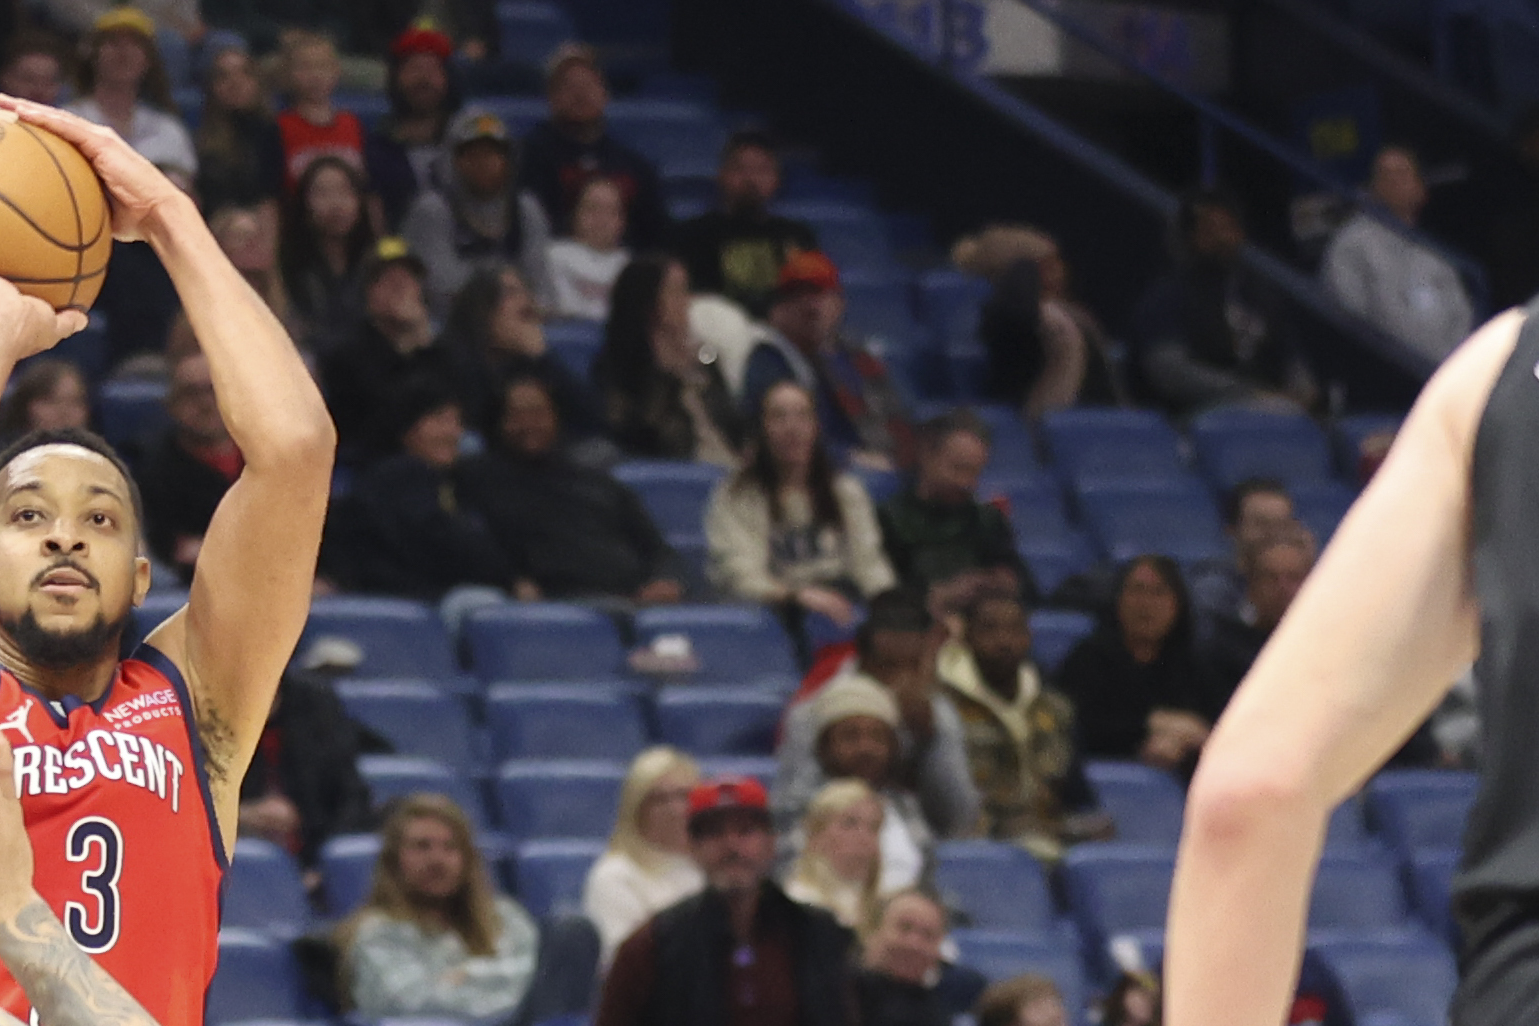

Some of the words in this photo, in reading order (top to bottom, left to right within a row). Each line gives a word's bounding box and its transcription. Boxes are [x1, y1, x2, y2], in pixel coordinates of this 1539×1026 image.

[104, 688, 176, 723] NEWAGE
[114, 705, 182, 731] PRODUCTS
[64, 815, 124, 954] 3
